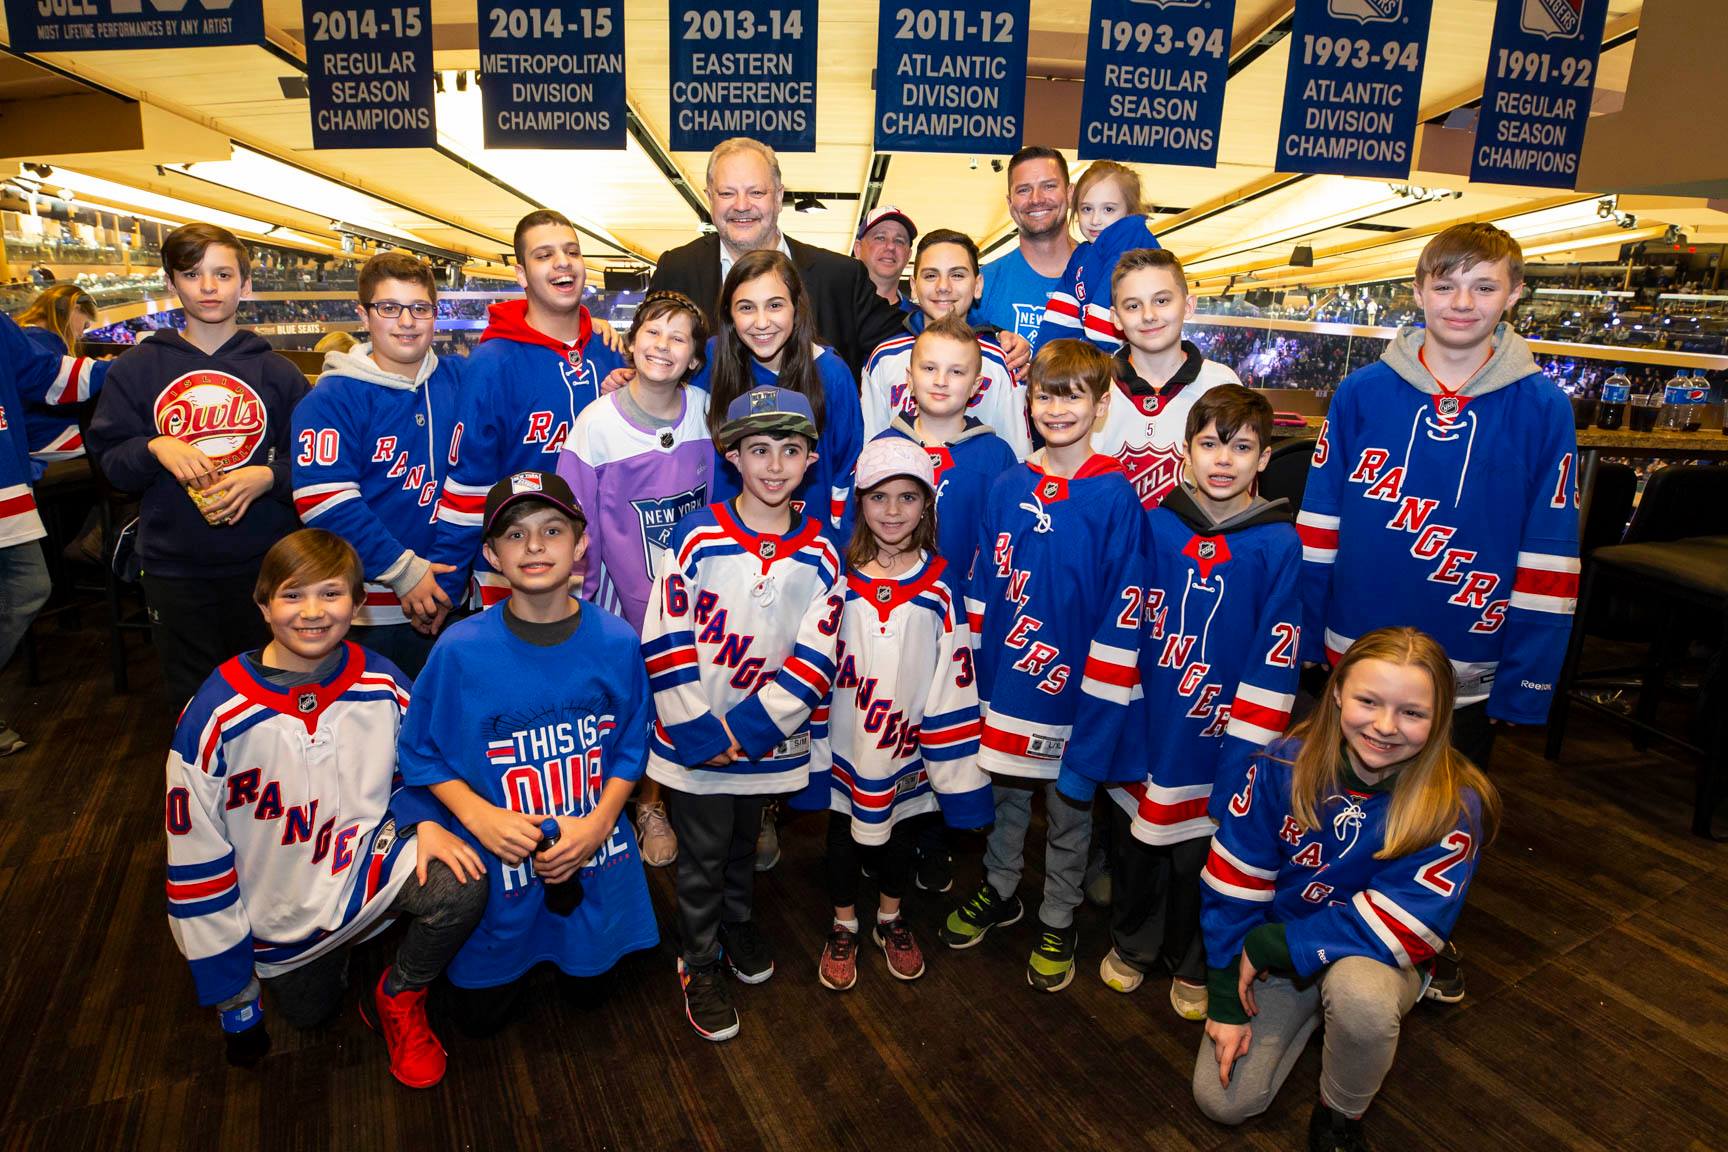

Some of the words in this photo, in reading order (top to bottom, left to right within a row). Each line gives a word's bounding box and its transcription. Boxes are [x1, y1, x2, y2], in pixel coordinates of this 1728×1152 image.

[36, 24, 60, 41] MOST
[63, 22, 95, 40] LIFETIME
[97, 19, 164, 39] PERFORMANCES
[166, 18, 177, 36] BY
[180, 18, 199, 36] ANY
[203, 17, 233, 35] ARTIST
[312, 7, 422, 41] 2014-15
[489, 7, 613, 38] 2014-15
[682, 10, 803, 40] 2013-14
[894, 8, 1014, 43] 2011-12
[1100, 19, 1224, 59] 1993-94
[1303, 34, 1419, 72] 1993-94
[323, 51, 416, 75] REGULAR
[482, 54, 622, 74] METROPOLITAN
[692, 53, 793, 75] EASTERN
[896, 53, 1007, 80] ATLANTIC
[1497, 48, 1592, 87] 1991-92
[331, 80, 410, 103] SEASON
[672, 81, 813, 104] CONFERENCE
[1104, 64, 1208, 93] REGULAR
[512, 83, 593, 103] DIVISION
[902, 83, 999, 109] DIVISION
[1302, 79, 1403, 107] ATLANTIC
[1495, 91, 1577, 120] REGULAR
[318, 108, 430, 131] CHAMPIONS
[498, 111, 610, 130] CHAMPIONS
[678, 109, 807, 131] CHAMPIONS
[1109, 94, 1198, 122] SEASON
[1305, 108, 1394, 134] DIVISION
[882, 111, 1016, 138] CHAMPIONS
[1087, 121, 1213, 151] CHAMPIONS
[1497, 120, 1567, 146] SEASON
[1285, 134, 1407, 163] CHAMPIONS
[1478, 146, 1577, 173] CHAMPIONS
[277, 323, 296, 335] BLUE
[297, 322, 320, 334] SEATS
[158, 394, 264, 446] Owls
[1146, 422, 1154, 437] 5
[297, 428, 339, 466] 30
[645, 508, 675, 525] NEW
[1348, 447, 1511, 634] RANGERS
[660, 573, 689, 618] 6
[1116, 585, 1144, 630] 2
[818, 594, 844, 637] 3
[952, 646, 975, 689] 3
[512, 722, 575, 762] THIS
[578, 714, 597, 750] IS
[1413, 829, 1478, 898] 2
